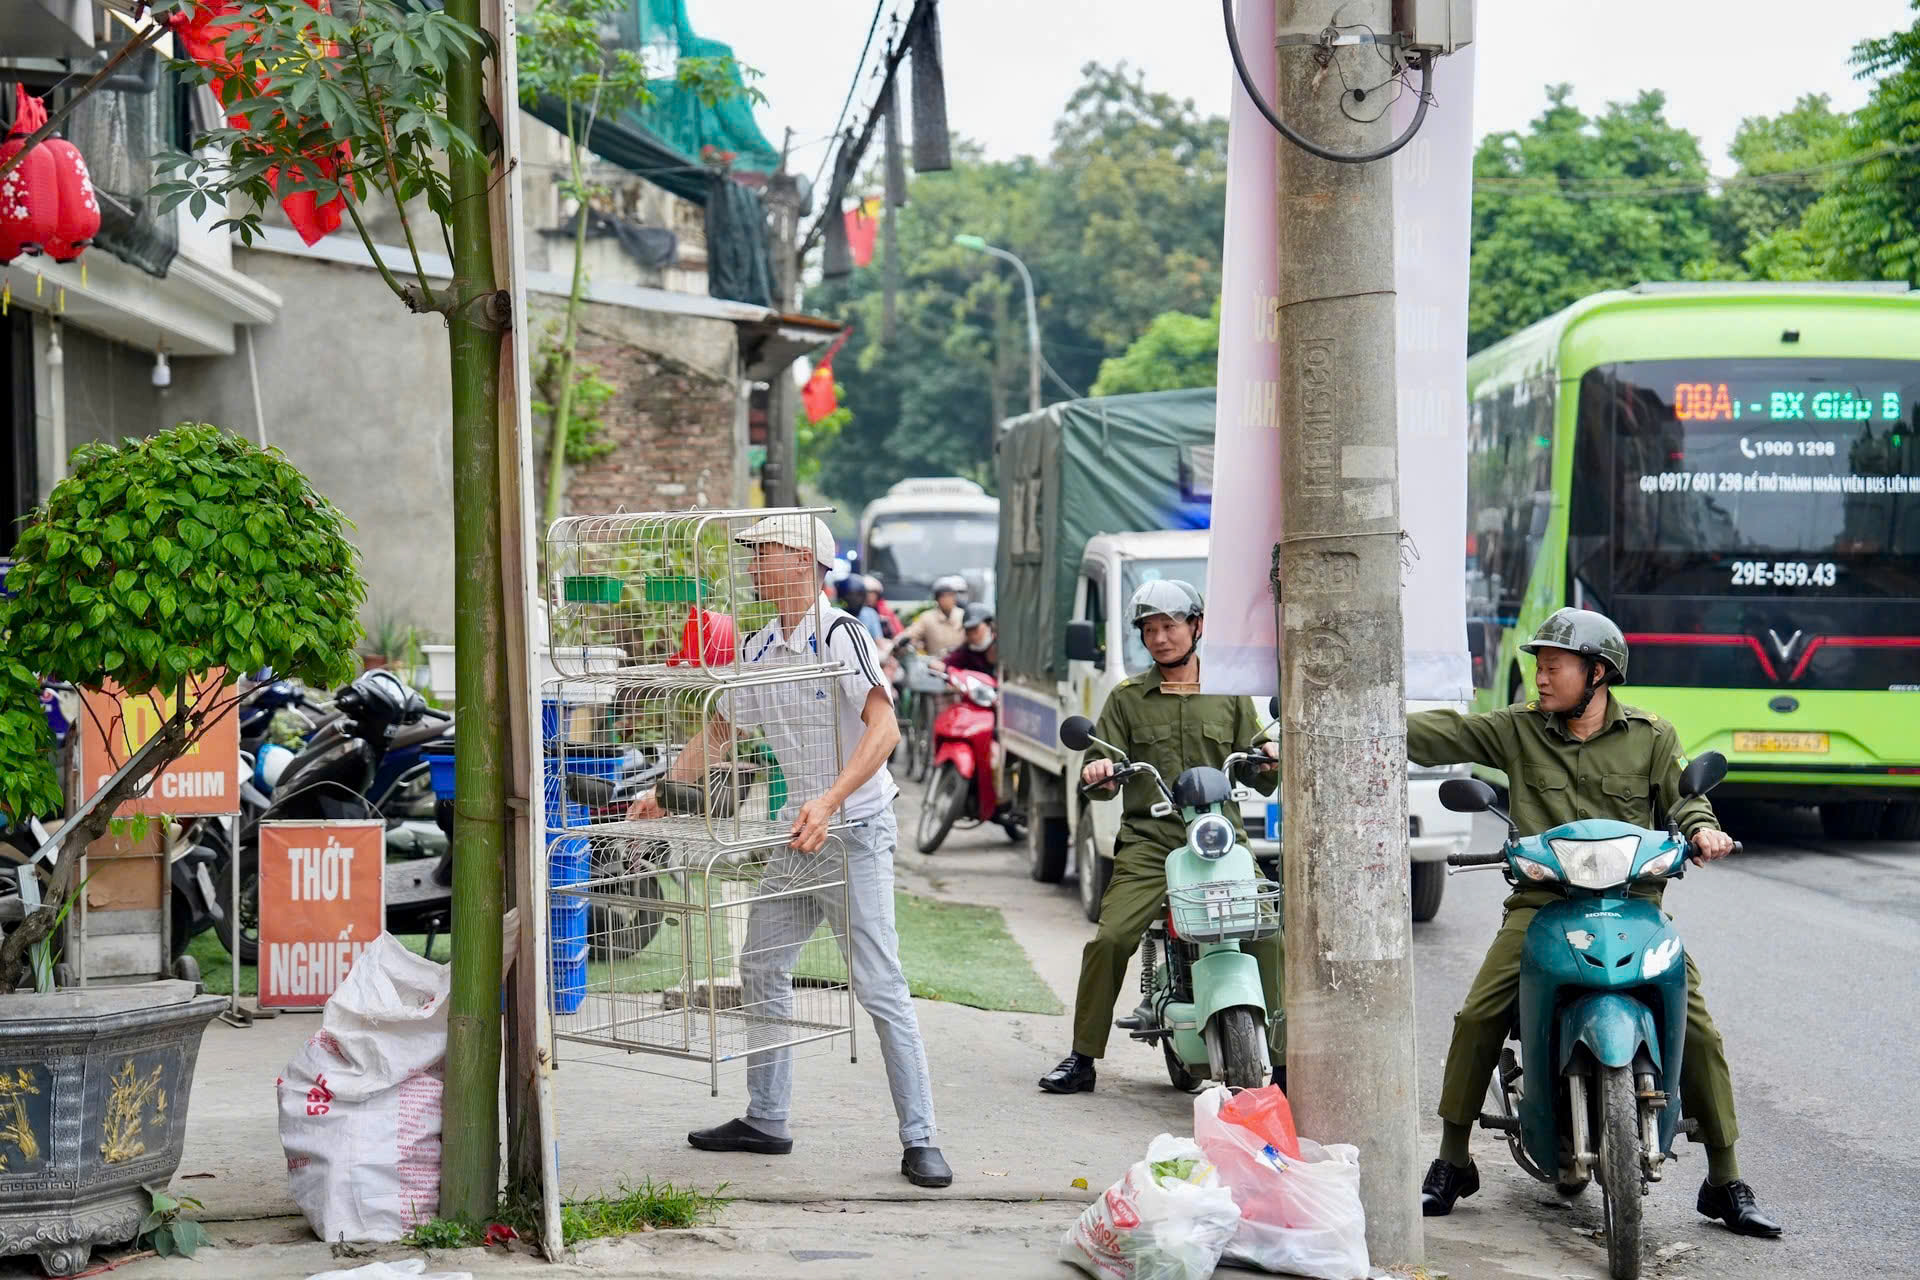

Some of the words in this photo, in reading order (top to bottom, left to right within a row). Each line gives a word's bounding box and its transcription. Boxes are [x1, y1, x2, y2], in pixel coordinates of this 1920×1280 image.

[1675, 384, 1732, 420] 08A
[1770, 392, 1805, 419] BX
[1755, 441, 1793, 456] 1900
[1797, 441, 1835, 456] 1298
[1659, 472, 1691, 492] 0917
[1692, 472, 1716, 492] 601
[1718, 472, 1743, 492] 298
[1866, 476, 1885, 493] BUS
[1731, 562, 1836, 587] 29E-559.43
[162, 771, 225, 798] CHIM
[288, 836, 354, 901] THỚT
[1584, 911, 1623, 919] HONDA
